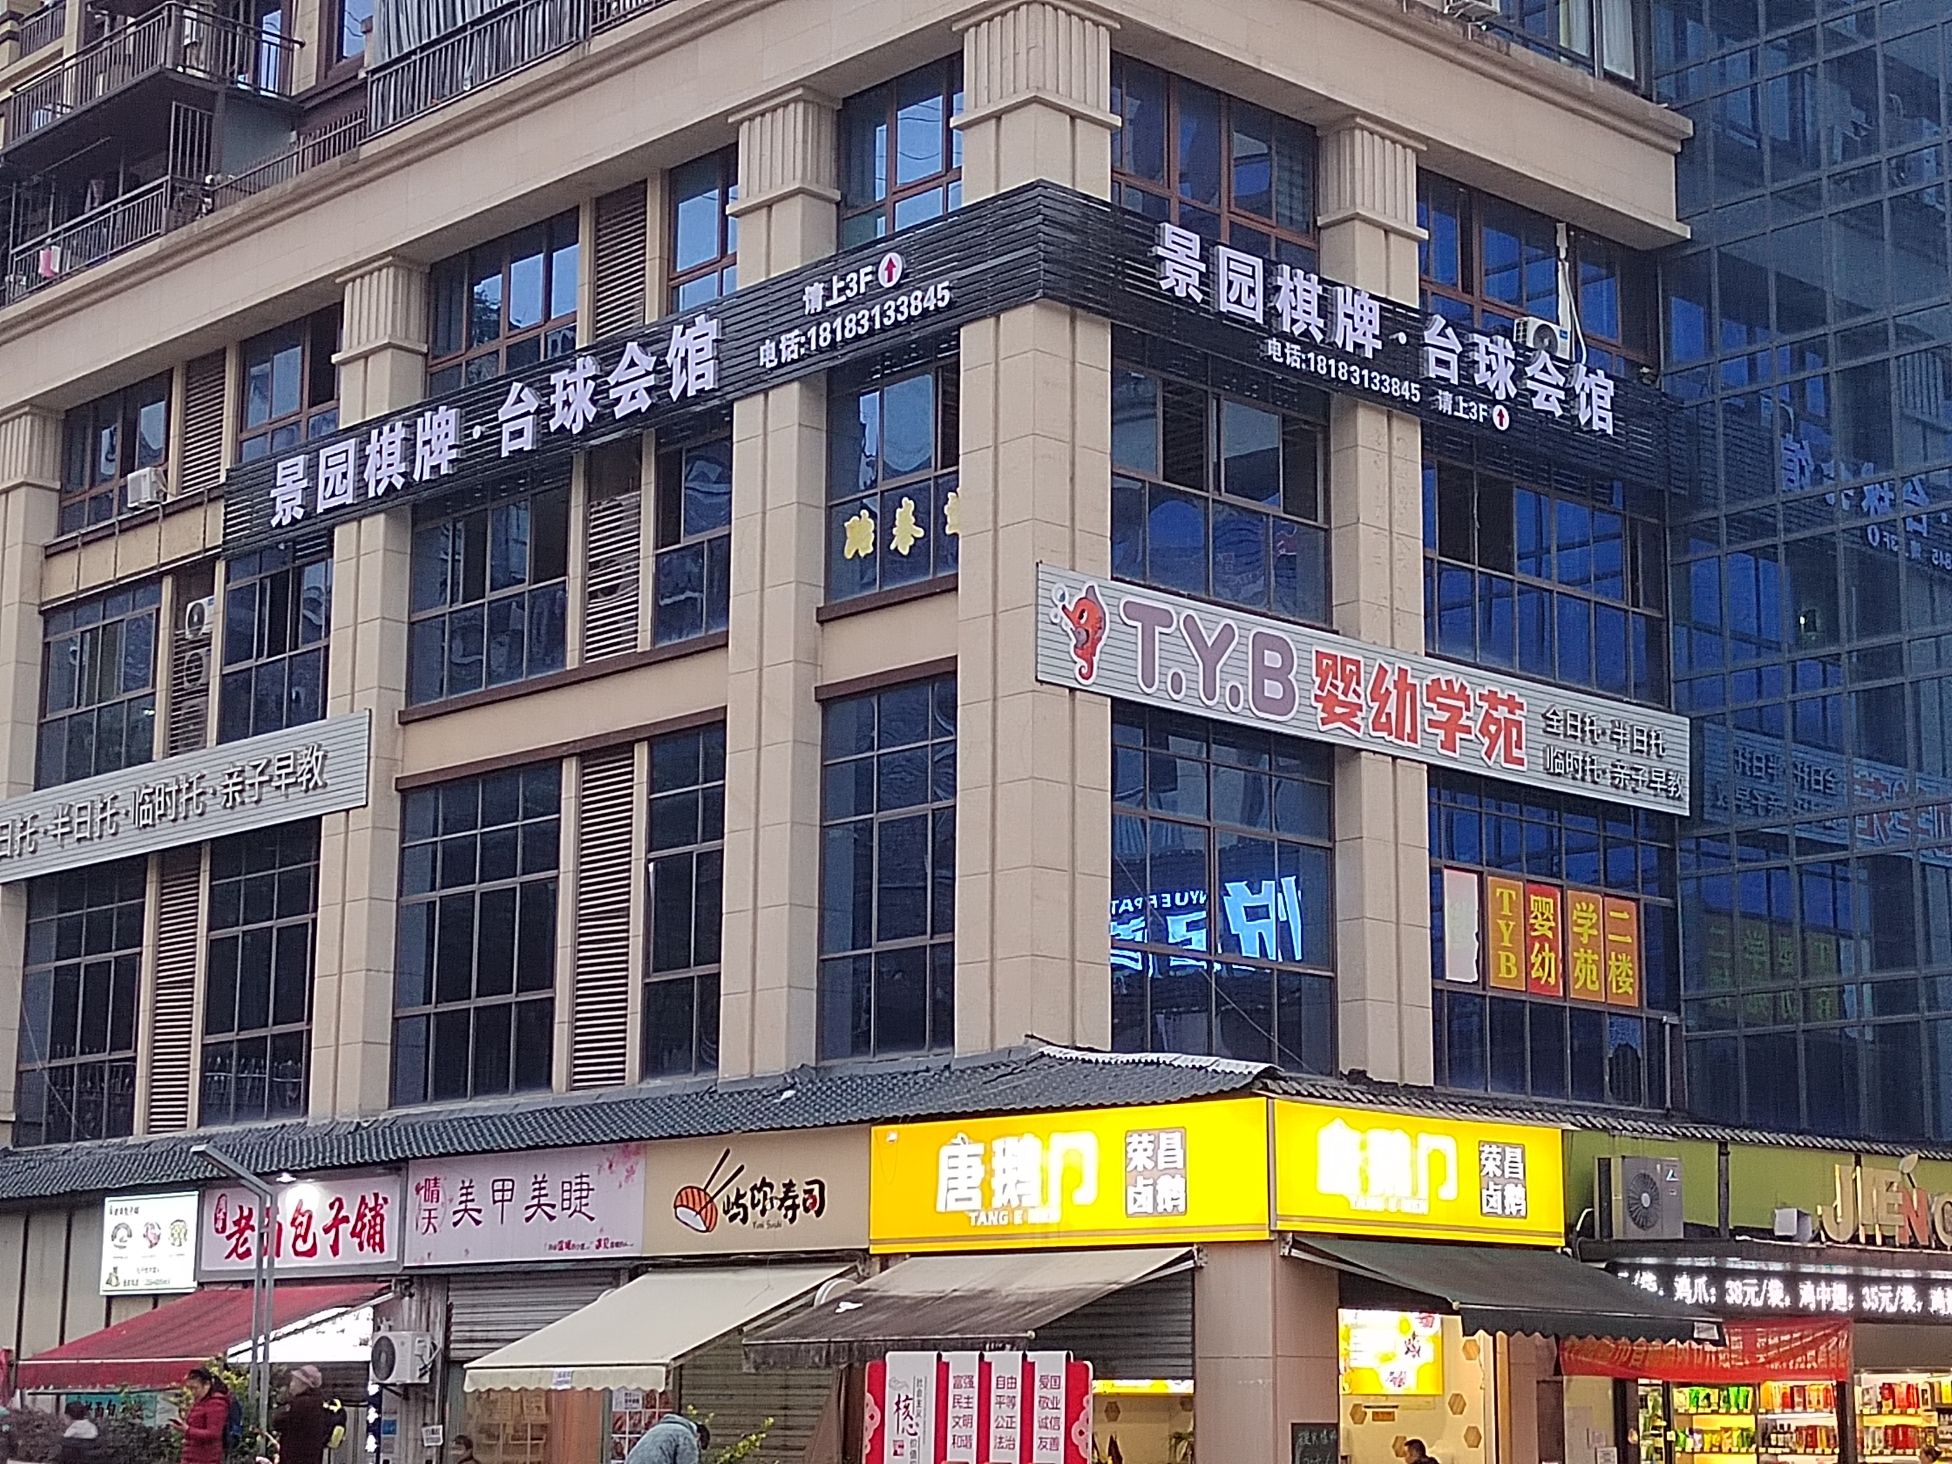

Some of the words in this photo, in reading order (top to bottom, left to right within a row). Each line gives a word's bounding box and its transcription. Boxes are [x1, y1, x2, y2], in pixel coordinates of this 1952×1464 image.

[803, 265, 873, 315] 请上3F
[759, 281, 950, 369] 电话:18183133845
[1152, 222, 1615, 435] 景园棋牌·台球会馆
[1267, 338, 1421, 403] 电话:18183133845
[270, 315, 721, 527] 景园棋牌·台球会馆
[1438, 390, 1489, 423] 请上3F
[1121, 600, 1297, 719] T.Y.B
[1313, 648, 1527, 772] 婴幼学苑
[1543, 705, 1667, 757] 全日托·半日托
[1544, 746, 1684, 799] 临时托·亲子早教
[1529, 895, 1555, 985] 婴幼
[1573, 902, 1599, 991] 学苑
[452, 1173, 596, 1228] 美甲美睫
[969, 1209, 1009, 1227] TANG
[952, 1394, 974, 1410] 民主
[995, 1375, 1017, 1390] 自由
[951, 1415, 973, 1429] 文明
[994, 1415, 1016, 1430] 公正
